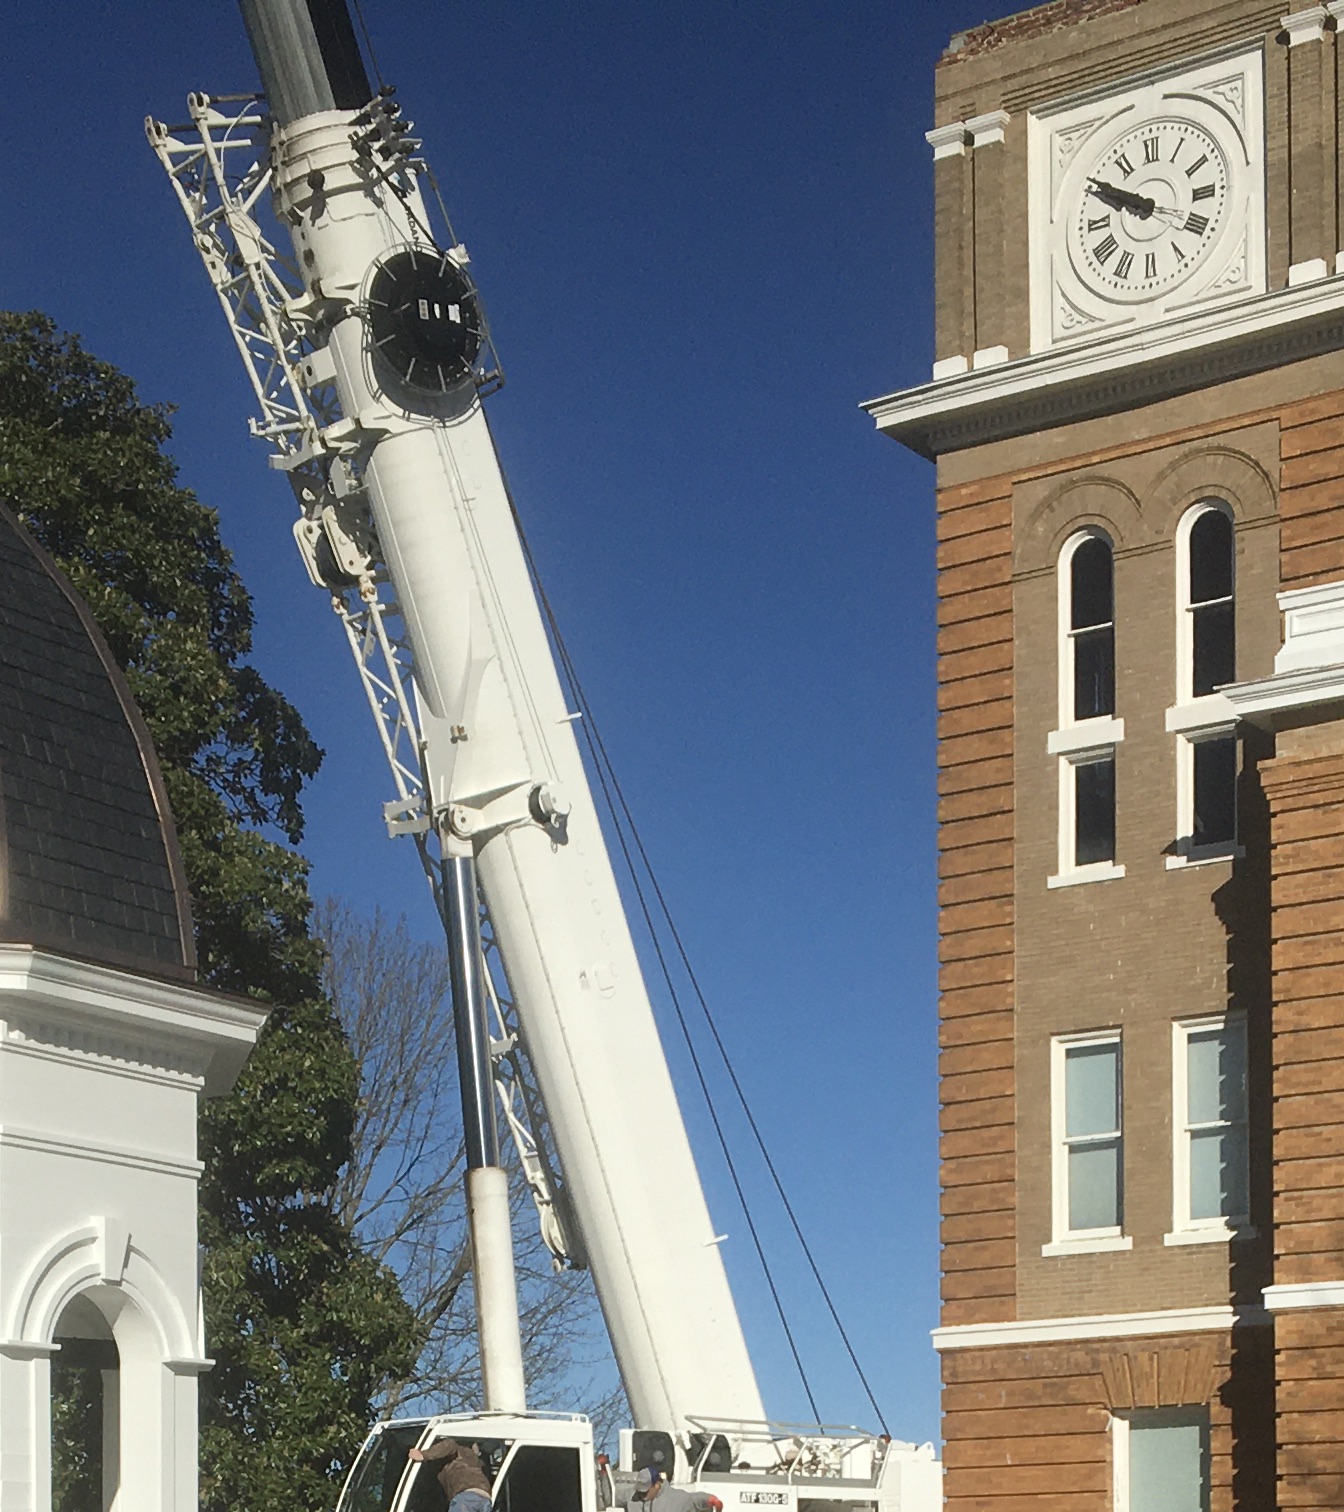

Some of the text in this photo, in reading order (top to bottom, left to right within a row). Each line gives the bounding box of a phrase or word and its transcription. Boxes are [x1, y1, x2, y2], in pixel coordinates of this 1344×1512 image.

[1143, 136, 1160, 166] XII
[1114, 152, 1136, 181] XI
[1185, 153, 1209, 179] II
[1087, 214, 1111, 234] IX
[1092, 232, 1120, 266] VIII
[1170, 241, 1186, 263] V
[1112, 250, 1135, 280] VII
[740, 1491, 757, 1503] ATF
